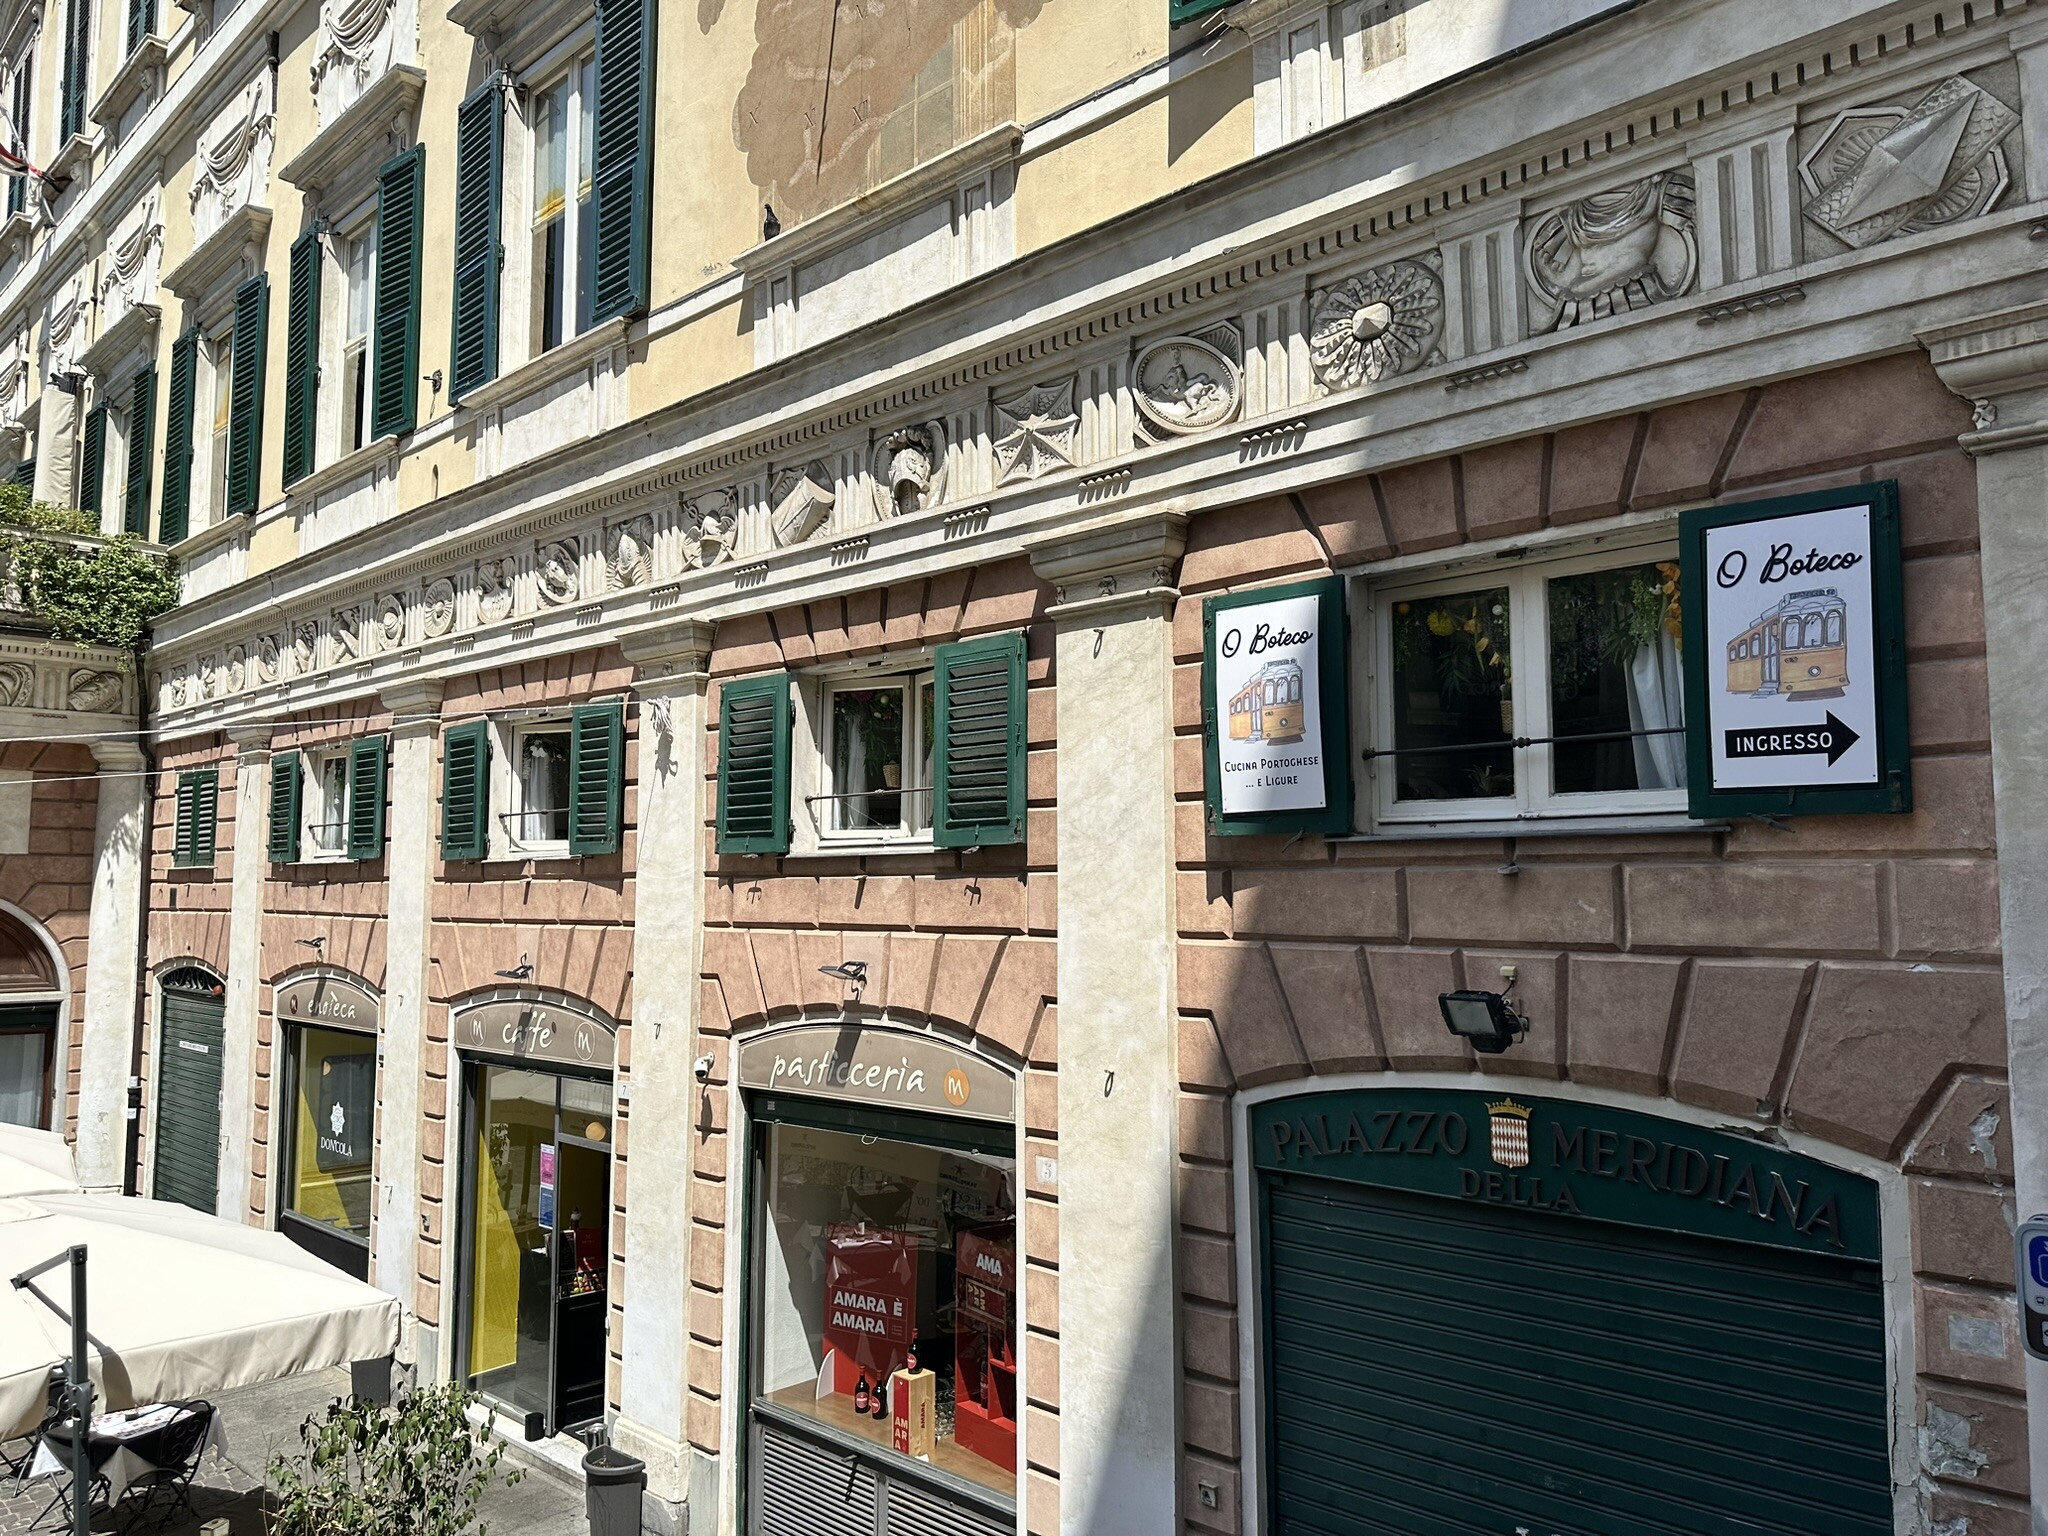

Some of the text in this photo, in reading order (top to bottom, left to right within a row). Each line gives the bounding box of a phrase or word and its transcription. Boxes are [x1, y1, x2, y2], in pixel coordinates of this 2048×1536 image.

[1716, 543, 1863, 588] O Boteco
[1221, 623, 1314, 658] O Boteco
[1736, 732, 1833, 752] INGRESSO
[1224, 756, 1319, 772] CUCINA PORTOGHESE
[1265, 775, 1298, 787] LIGURE
[769, 1050, 927, 1093] pasticceria
[622, 1085, 627, 1095] 7
[1268, 1111, 1845, 1248] PALAZZO MERIDIANA
[1458, 1167, 1581, 1213] DELLA
[976, 1253, 1003, 1277] AMA
[833, 1290, 903, 1317] AMARA È
[832, 1311, 886, 1335] AMARA
[894, 1416, 908, 1430] AM
[894, 1427, 907, 1441] AR
[894, 1439, 901, 1450] A
